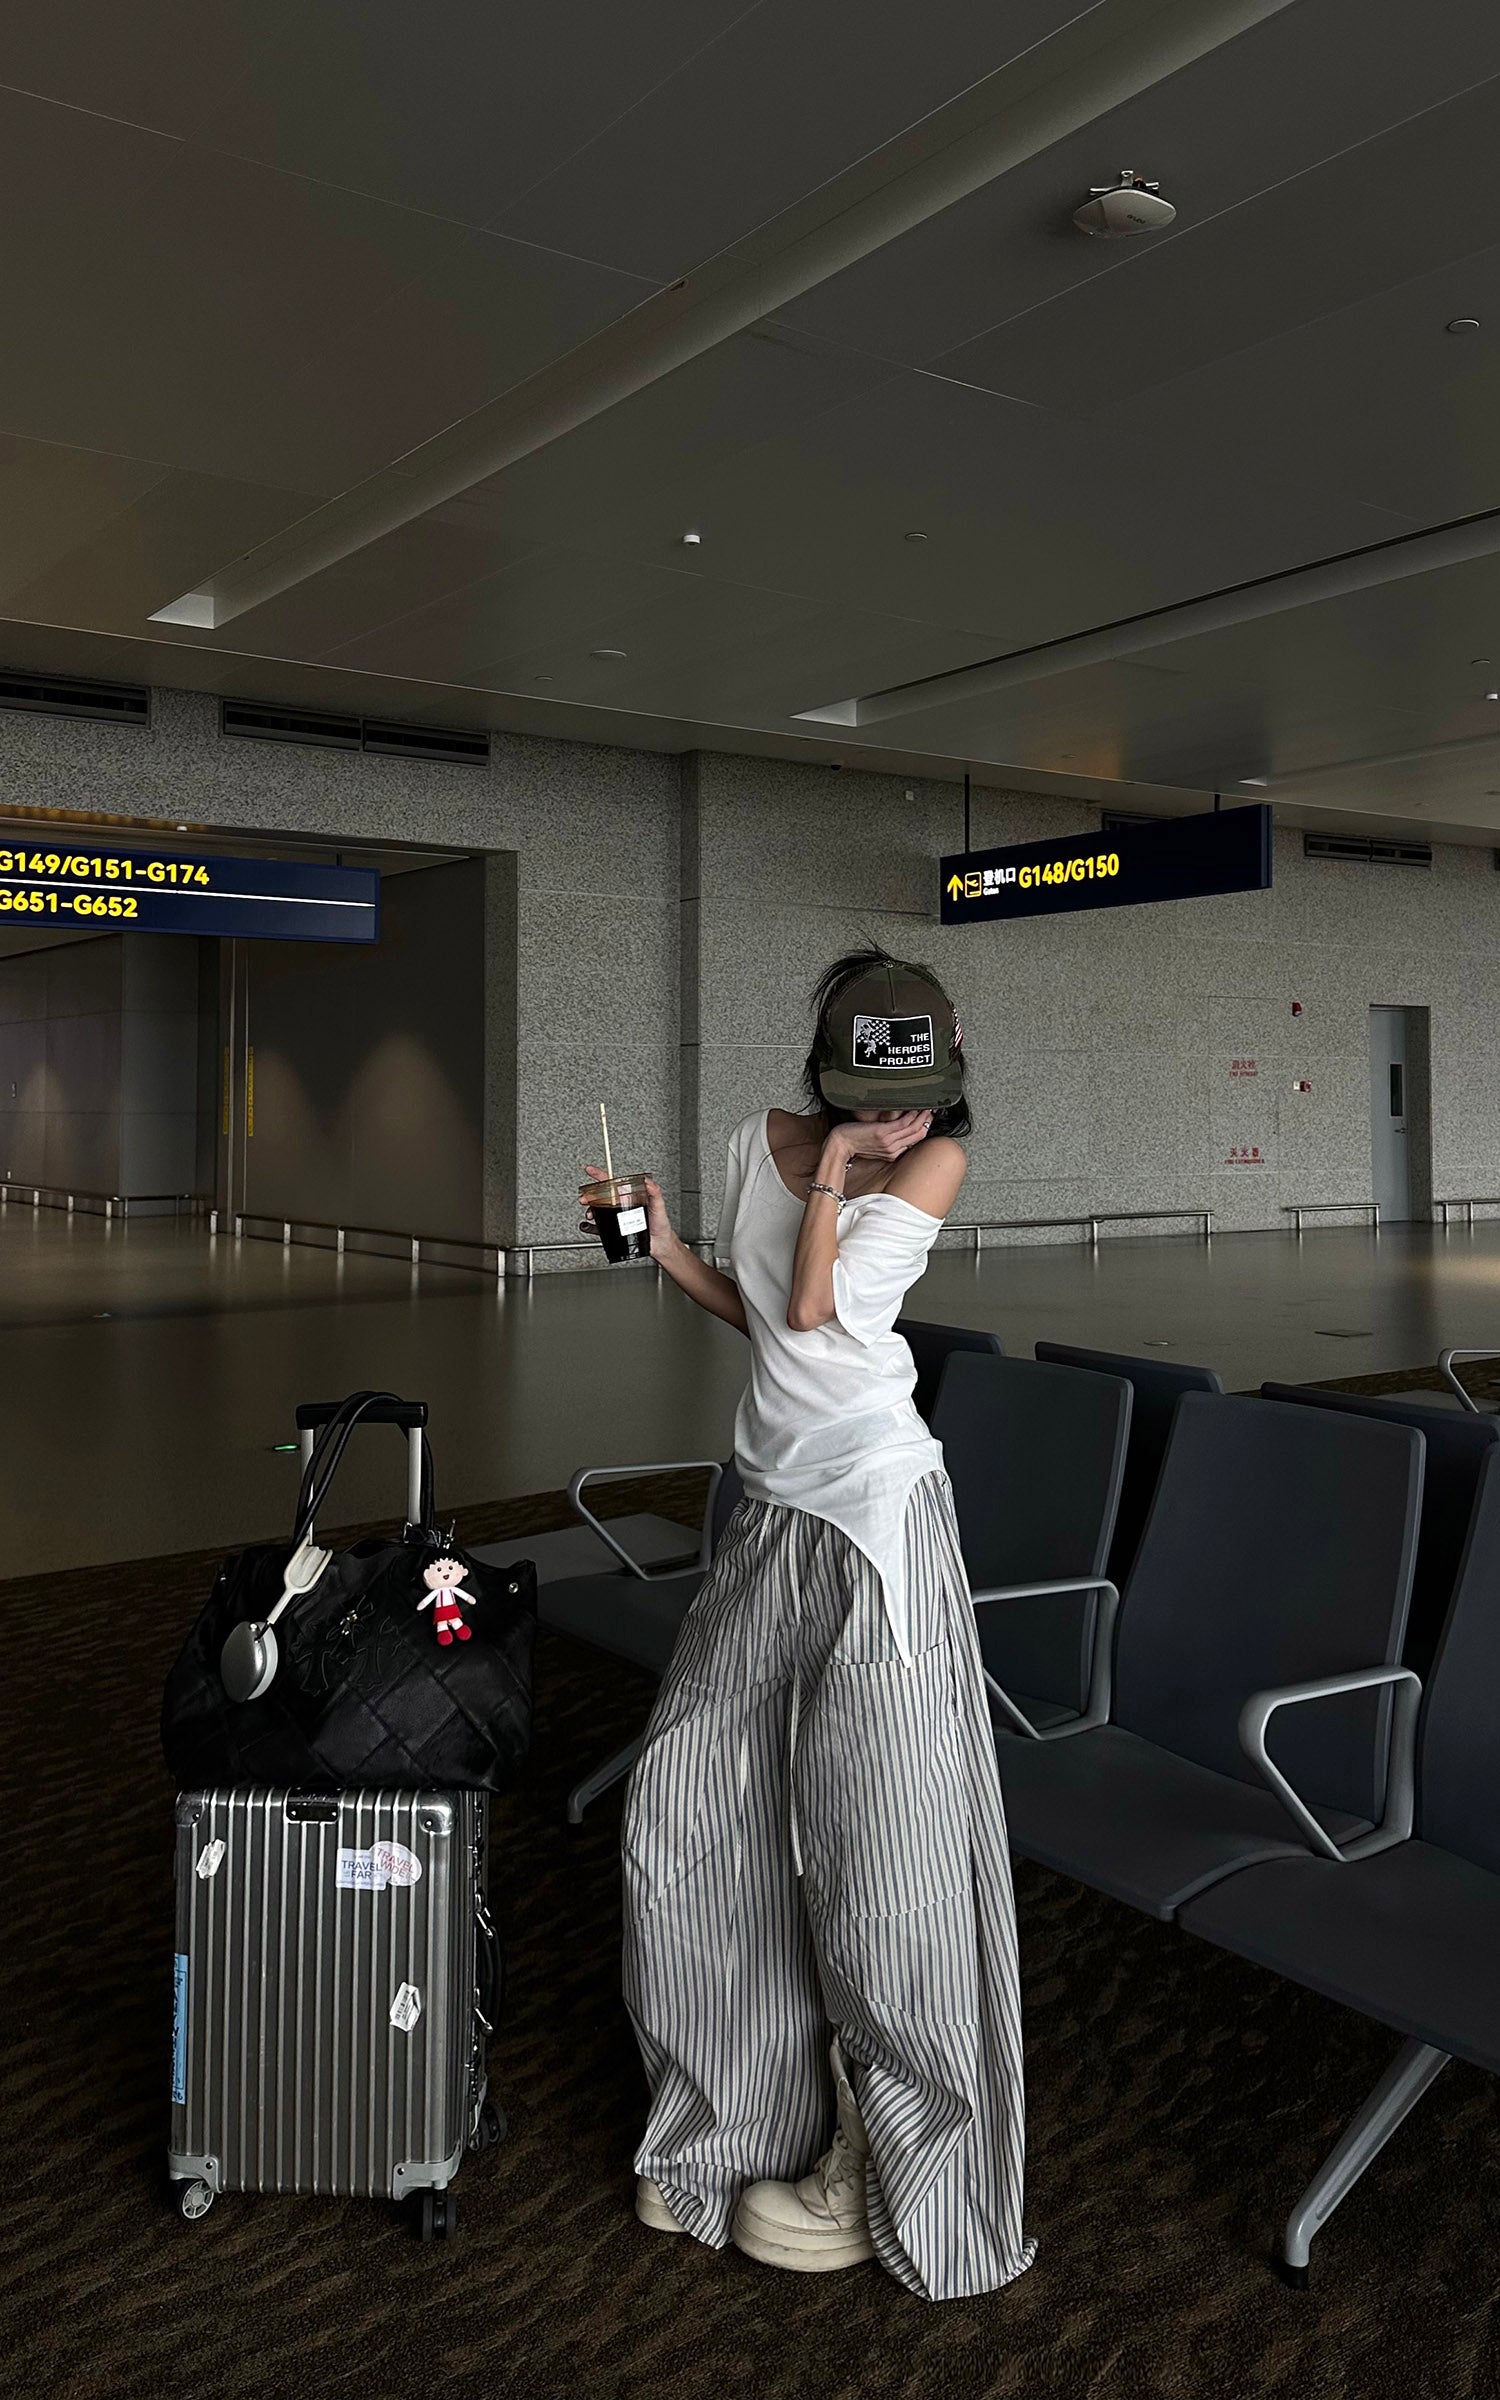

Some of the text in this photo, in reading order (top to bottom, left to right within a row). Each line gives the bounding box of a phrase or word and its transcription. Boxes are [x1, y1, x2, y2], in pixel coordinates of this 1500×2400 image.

[0, 851, 210, 885] G149/G151-G174
[983, 853, 1120, 888] 登机口 G148/G150
[0, 889, 138, 918] G651-G652
[910, 1033, 929, 1042] THE
[888, 1044, 930, 1054] HEROES
[879, 1055, 930, 1065] PROJECT
[342, 1860, 382, 1871] TRAVEL
[377, 1848, 415, 1874] TRAVEL
[351, 1870, 372, 1879] FAR
